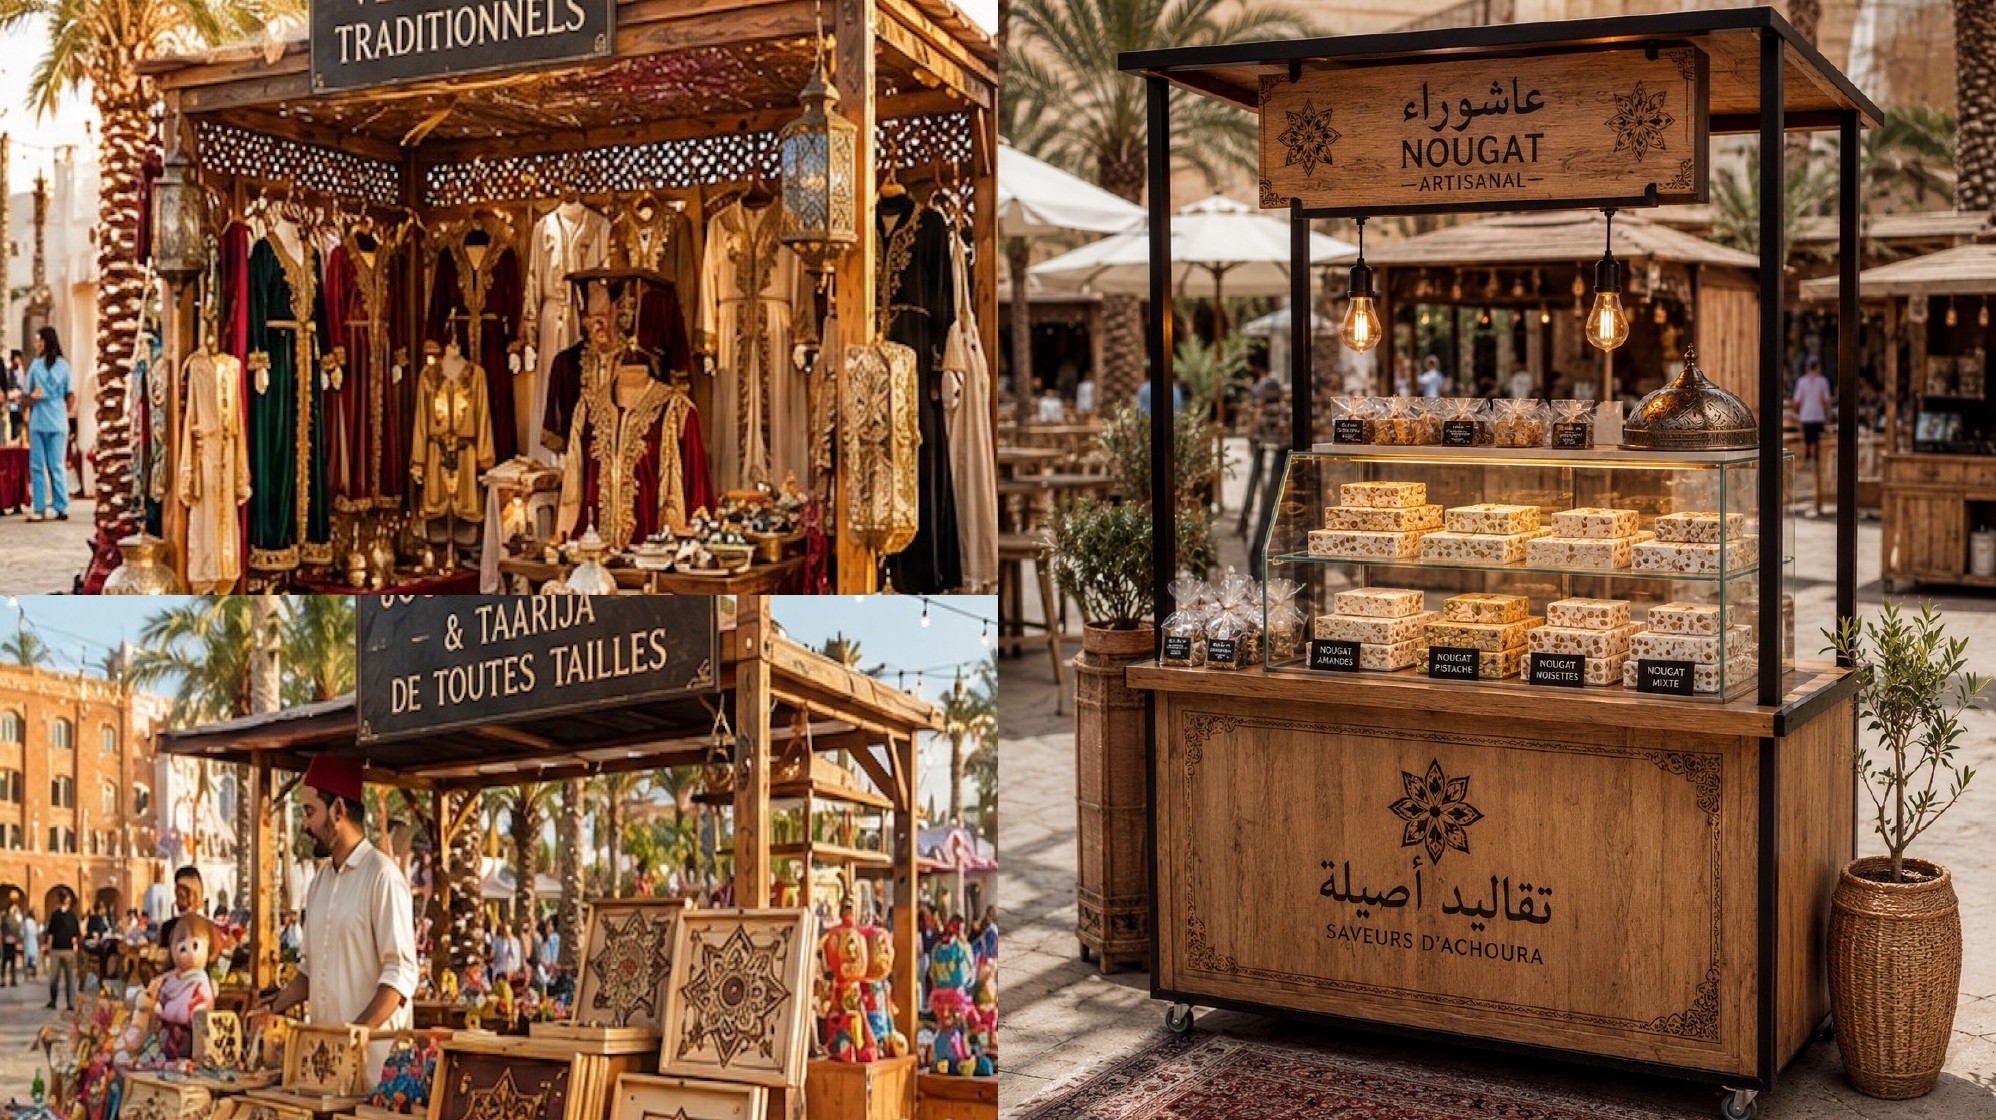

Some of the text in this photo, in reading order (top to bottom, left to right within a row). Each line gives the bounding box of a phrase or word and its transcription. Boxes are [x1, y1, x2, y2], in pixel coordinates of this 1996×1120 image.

[334, 0, 586, 64] TRADITIONNELS
[1403, 76, 1546, 132] عاشوراء
[1401, 133, 1545, 169] NOUGAT
[1418, 173, 1527, 192] ARTISANAL
[444, 595, 596, 651] & TAARIJA
[1319, 645, 1353, 656] NOUGAT
[1437, 653, 1473, 663] NOUGAT
[1317, 656, 1354, 667] AMANDES
[1434, 664, 1473, 674] PISTACHE
[1539, 659, 1576, 670] NOUGAT
[391, 628, 668, 714] DE TOUTES TAILLES
[1536, 671, 1579, 682] NOISETTES
[1647, 666, 1686, 678] NOUGAT
[1652, 678, 1680, 689] MIXTE
[1320, 855, 1553, 932] تقاليد أصيلة
[1326, 923, 1544, 965] SAVEURS D'ACHOURA
